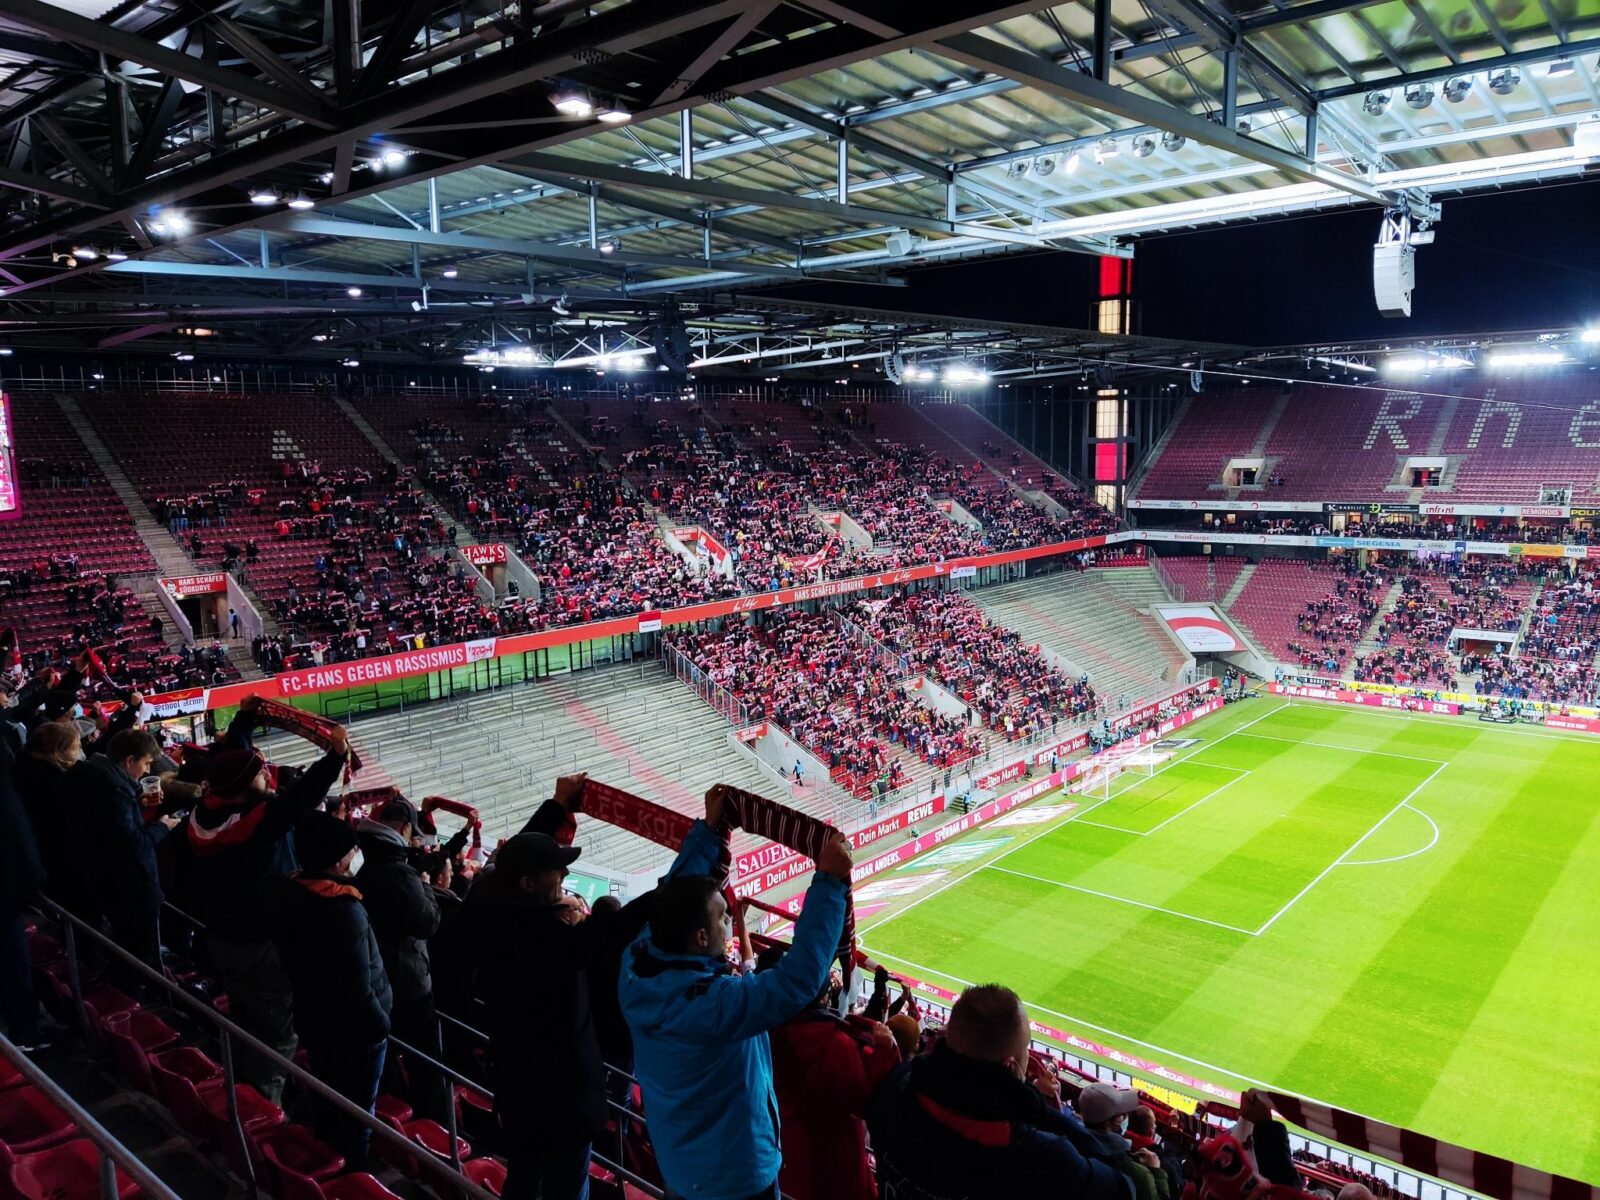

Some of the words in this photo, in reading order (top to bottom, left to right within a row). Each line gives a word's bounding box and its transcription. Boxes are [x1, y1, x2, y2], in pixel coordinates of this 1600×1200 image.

[461, 545, 505, 561] HAWKS
[474, 556, 495, 564] KÖLN
[178, 578, 195, 586] HANS
[196, 575, 224, 585] SCHÄFER
[179, 584, 212, 594] SÜDKURVE
[794, 589, 810, 601] HANS
[282, 669, 344, 693] FC-FANS
[347, 658, 393, 683] GEGEN
[395, 648, 464, 674] RASSISMUS
[154, 700, 181, 712] School
[1001, 766, 1019, 781] Markt
[598, 796, 627, 820] FC
[859, 828, 877, 847] Dein
[877, 818, 900, 838] Markt
[907, 801, 934, 825] REWE
[738, 843, 798, 877] SAUER
[766, 868, 787, 888] Dein
